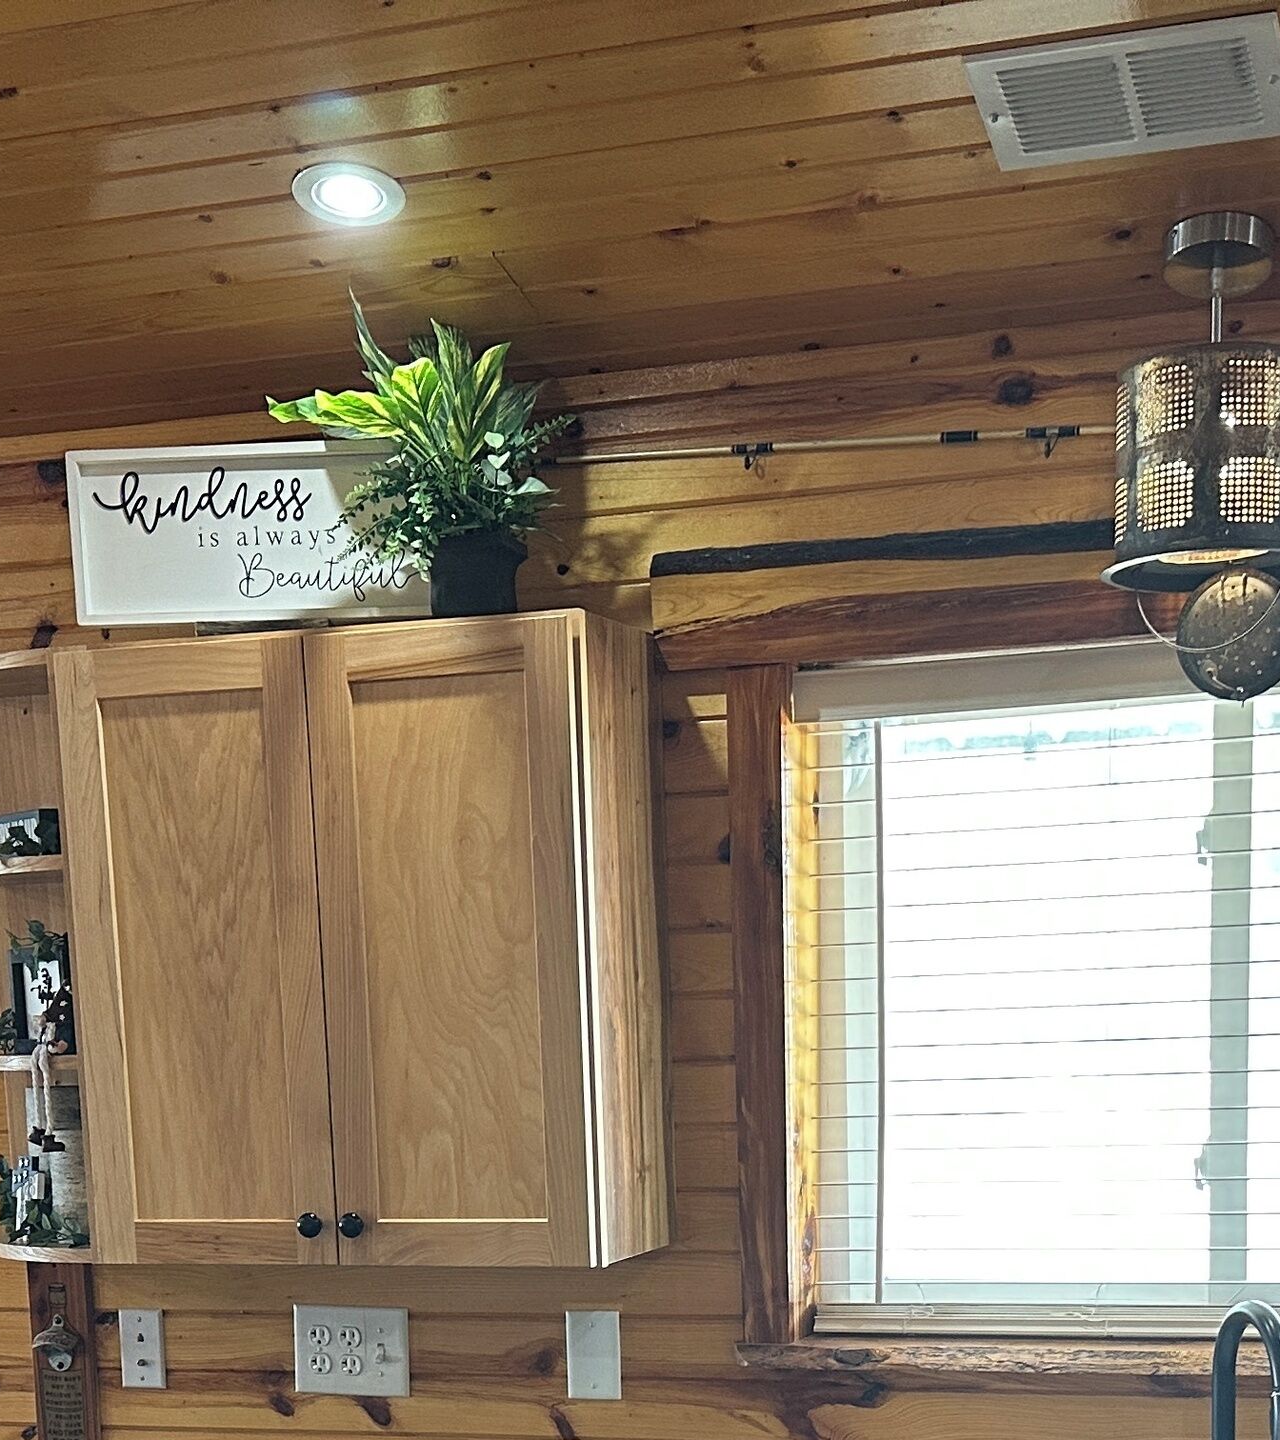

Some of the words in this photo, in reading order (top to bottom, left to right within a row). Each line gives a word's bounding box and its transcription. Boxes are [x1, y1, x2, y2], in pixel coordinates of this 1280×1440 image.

[92, 466, 313, 535] kindness
[197, 527, 220, 548] is
[236, 525, 337, 550] always
[237, 550, 422, 602] Beautiful
